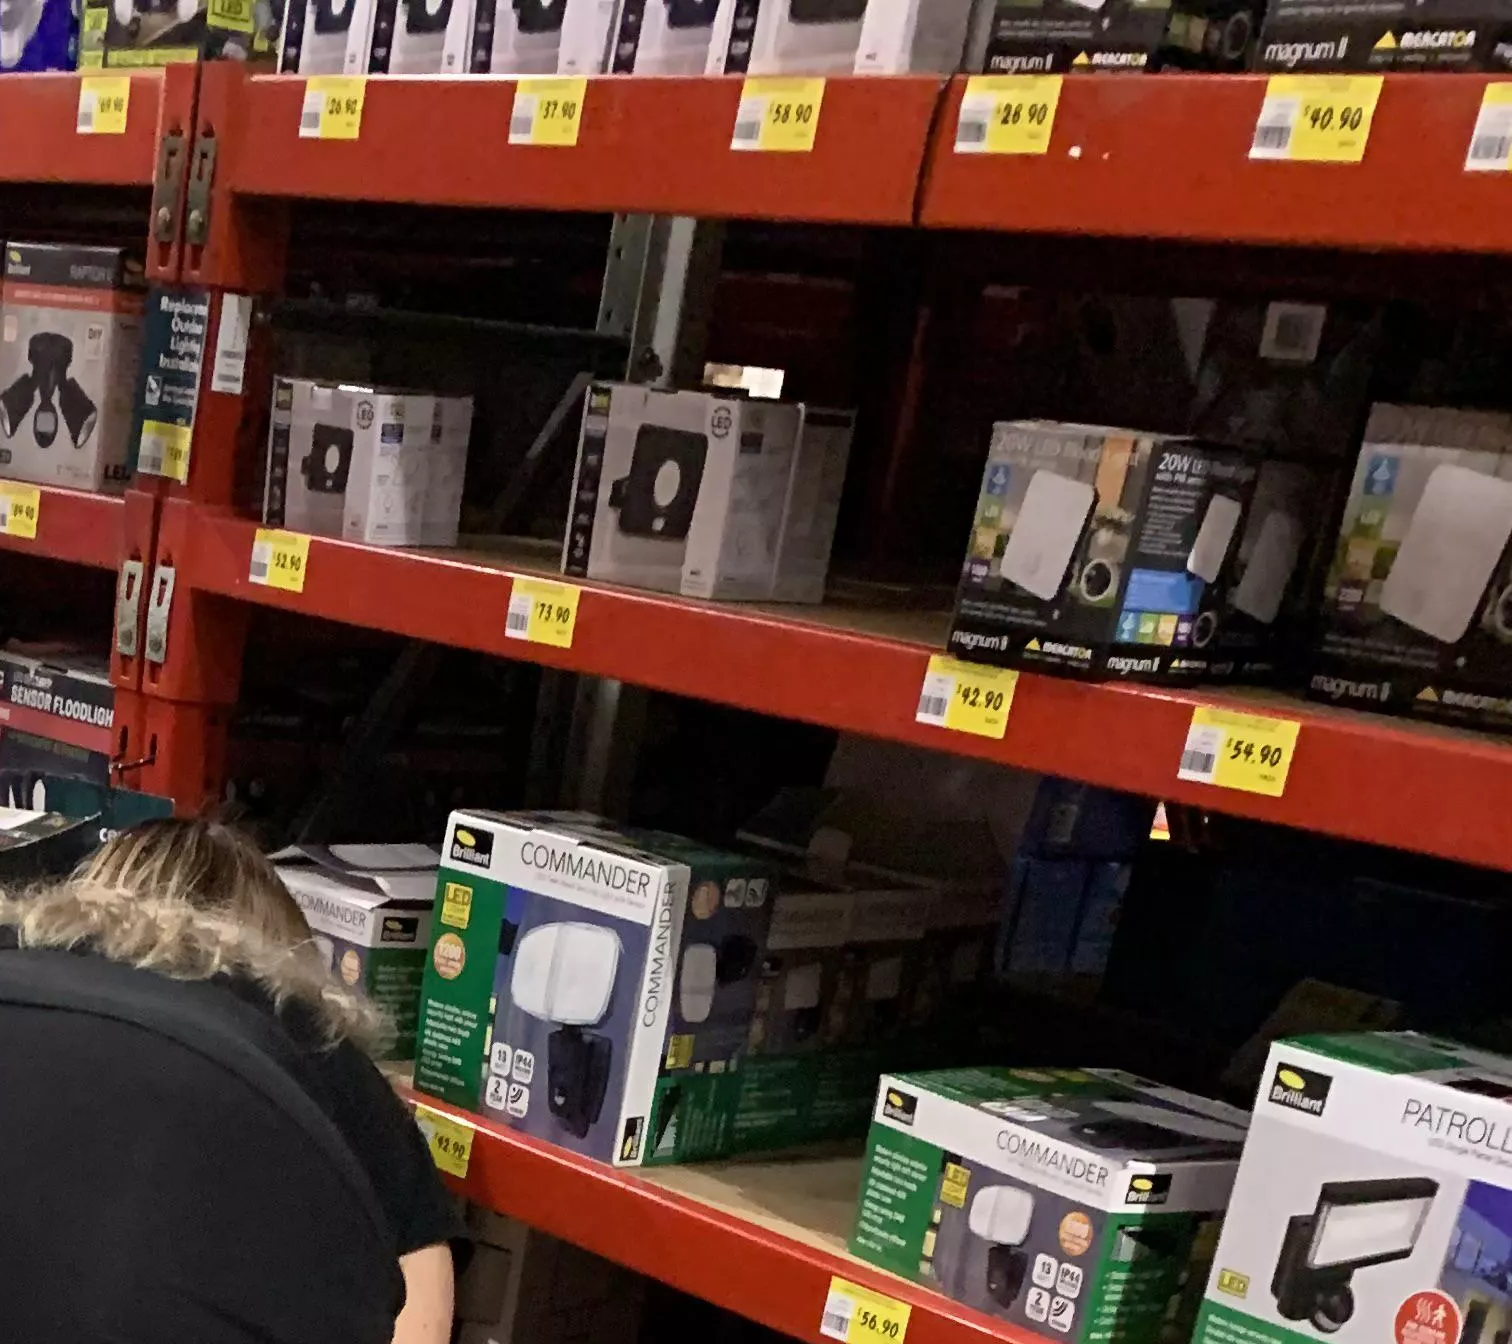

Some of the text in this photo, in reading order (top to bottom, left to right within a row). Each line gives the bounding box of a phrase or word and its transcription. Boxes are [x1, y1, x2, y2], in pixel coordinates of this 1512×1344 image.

[1304, 104, 1364, 132] $40.90
[11, 685, 51, 714] SENSOR
[956, 683, 1005, 712] $42.90
[1225, 738, 1283, 768] $54.90
[520, 840, 651, 900] COMMANDER
[643, 881, 677, 1028] COMMANDER
[996, 1128, 1109, 1188] COMMANDER
[1040, 1260, 1055, 1280] 13
[1032, 1290, 1044, 1309] 2
[858, 1306, 900, 1339] $56.90
